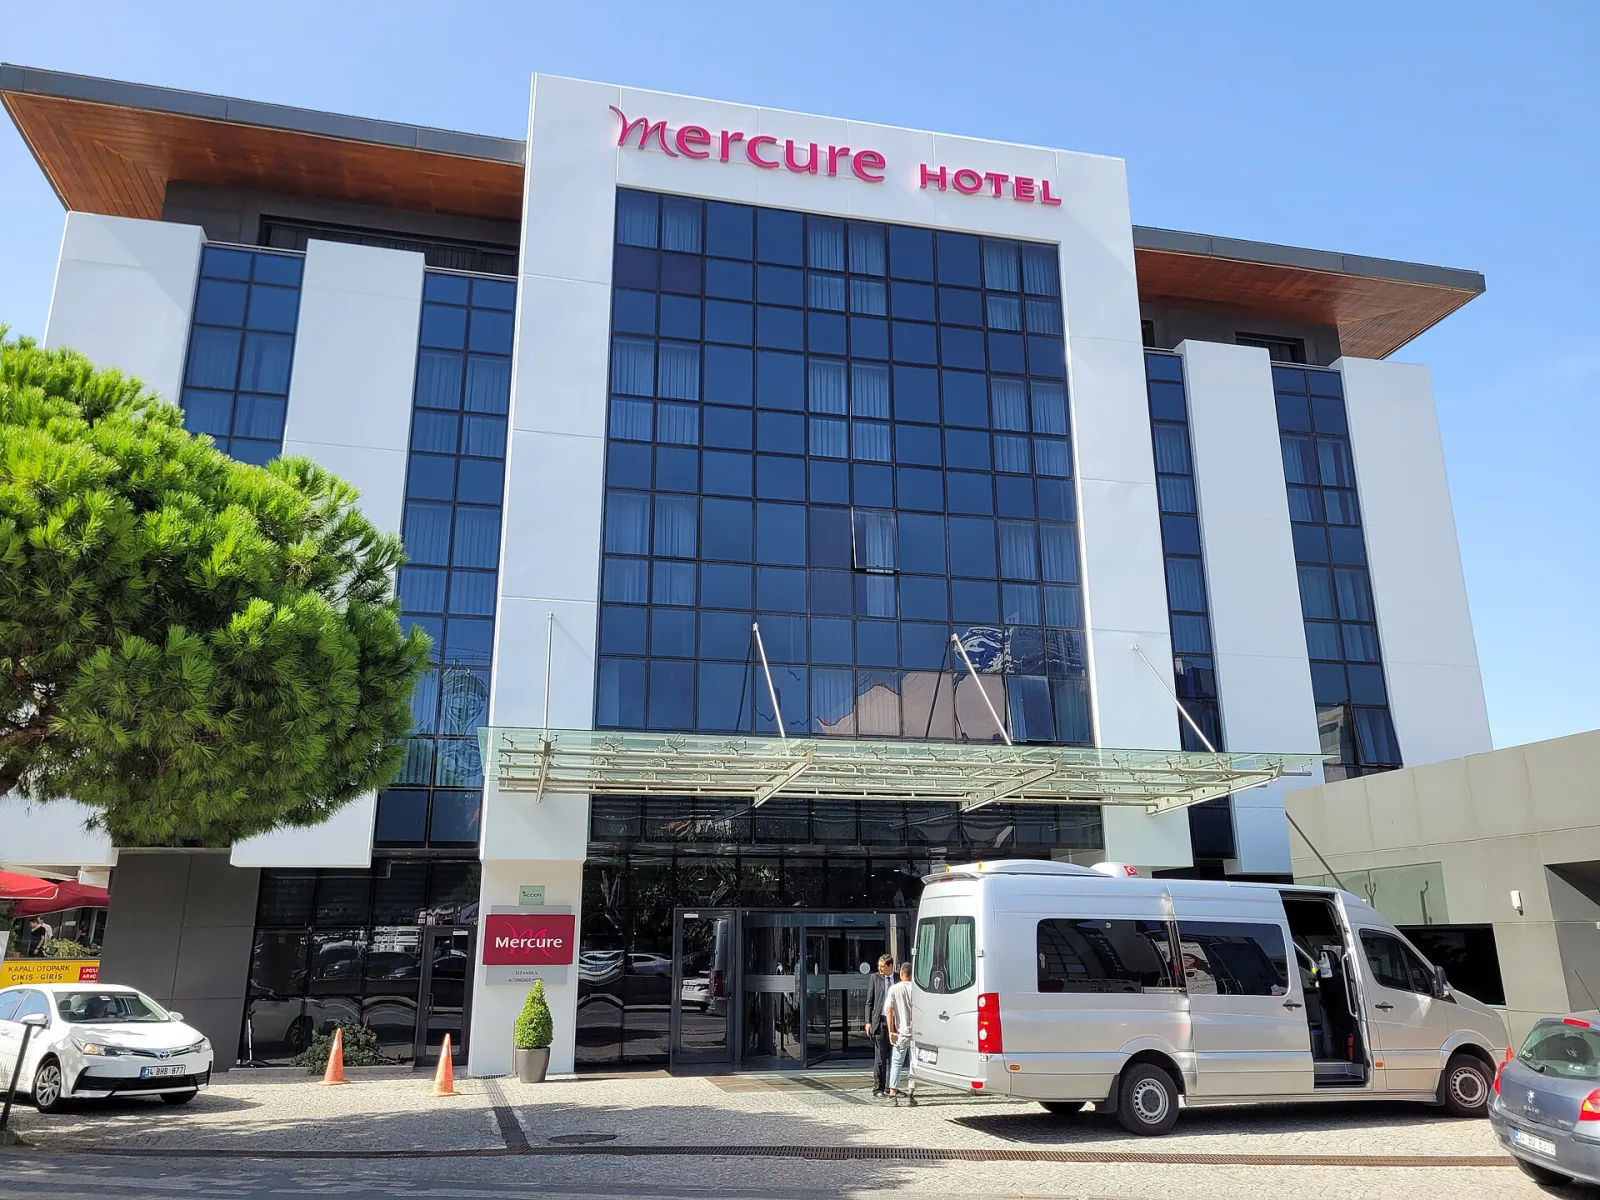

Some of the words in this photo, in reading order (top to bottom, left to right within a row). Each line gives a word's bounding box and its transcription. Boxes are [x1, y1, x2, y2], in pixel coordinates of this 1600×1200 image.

[919, 163, 1062, 206] HOTEL
[495, 936, 563, 949] Mercure
[8, 965, 35, 973] KAPALI
[36, 964, 71, 972] OTOPARK
